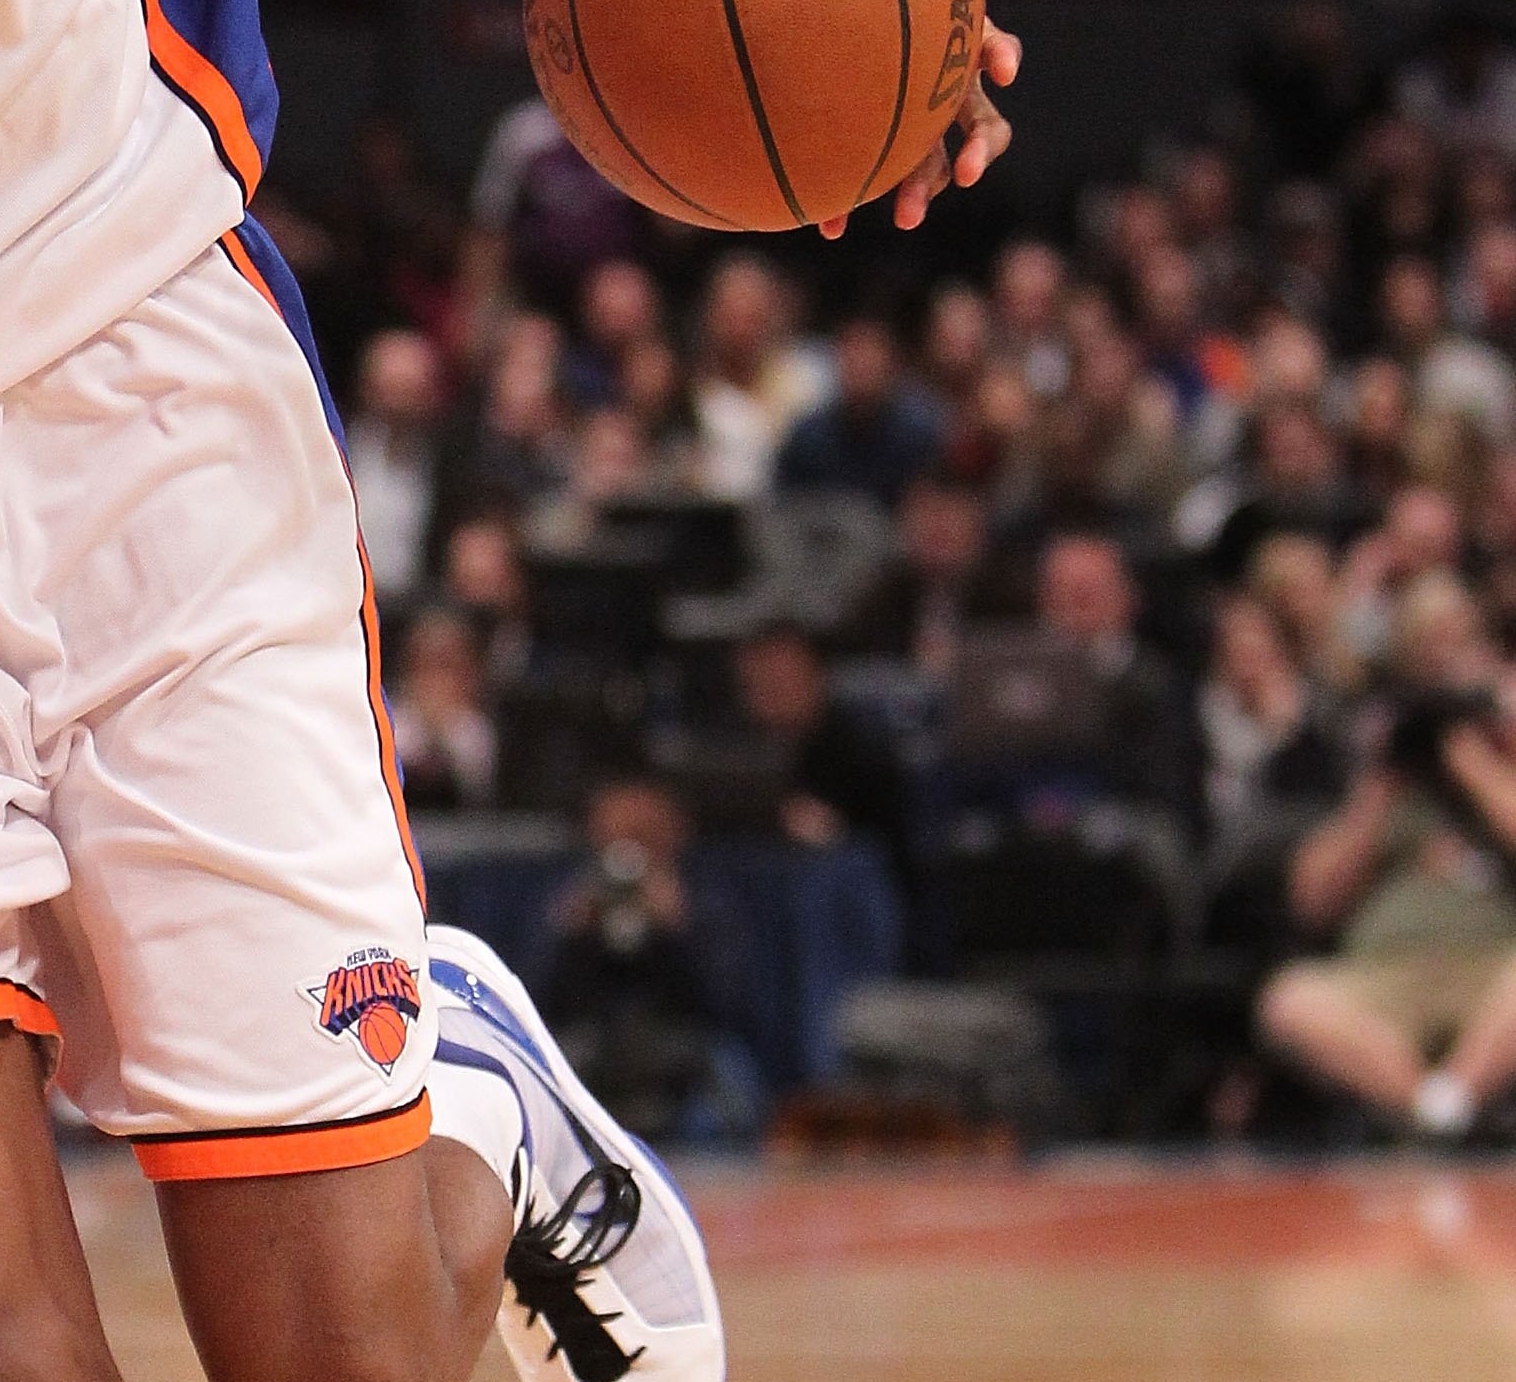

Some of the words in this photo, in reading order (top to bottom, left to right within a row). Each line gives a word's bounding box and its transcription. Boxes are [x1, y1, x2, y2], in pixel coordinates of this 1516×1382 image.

[346, 949, 366, 967] NEW
[367, 947, 391, 960] YORK
[320, 957, 421, 1033] KNICKS
